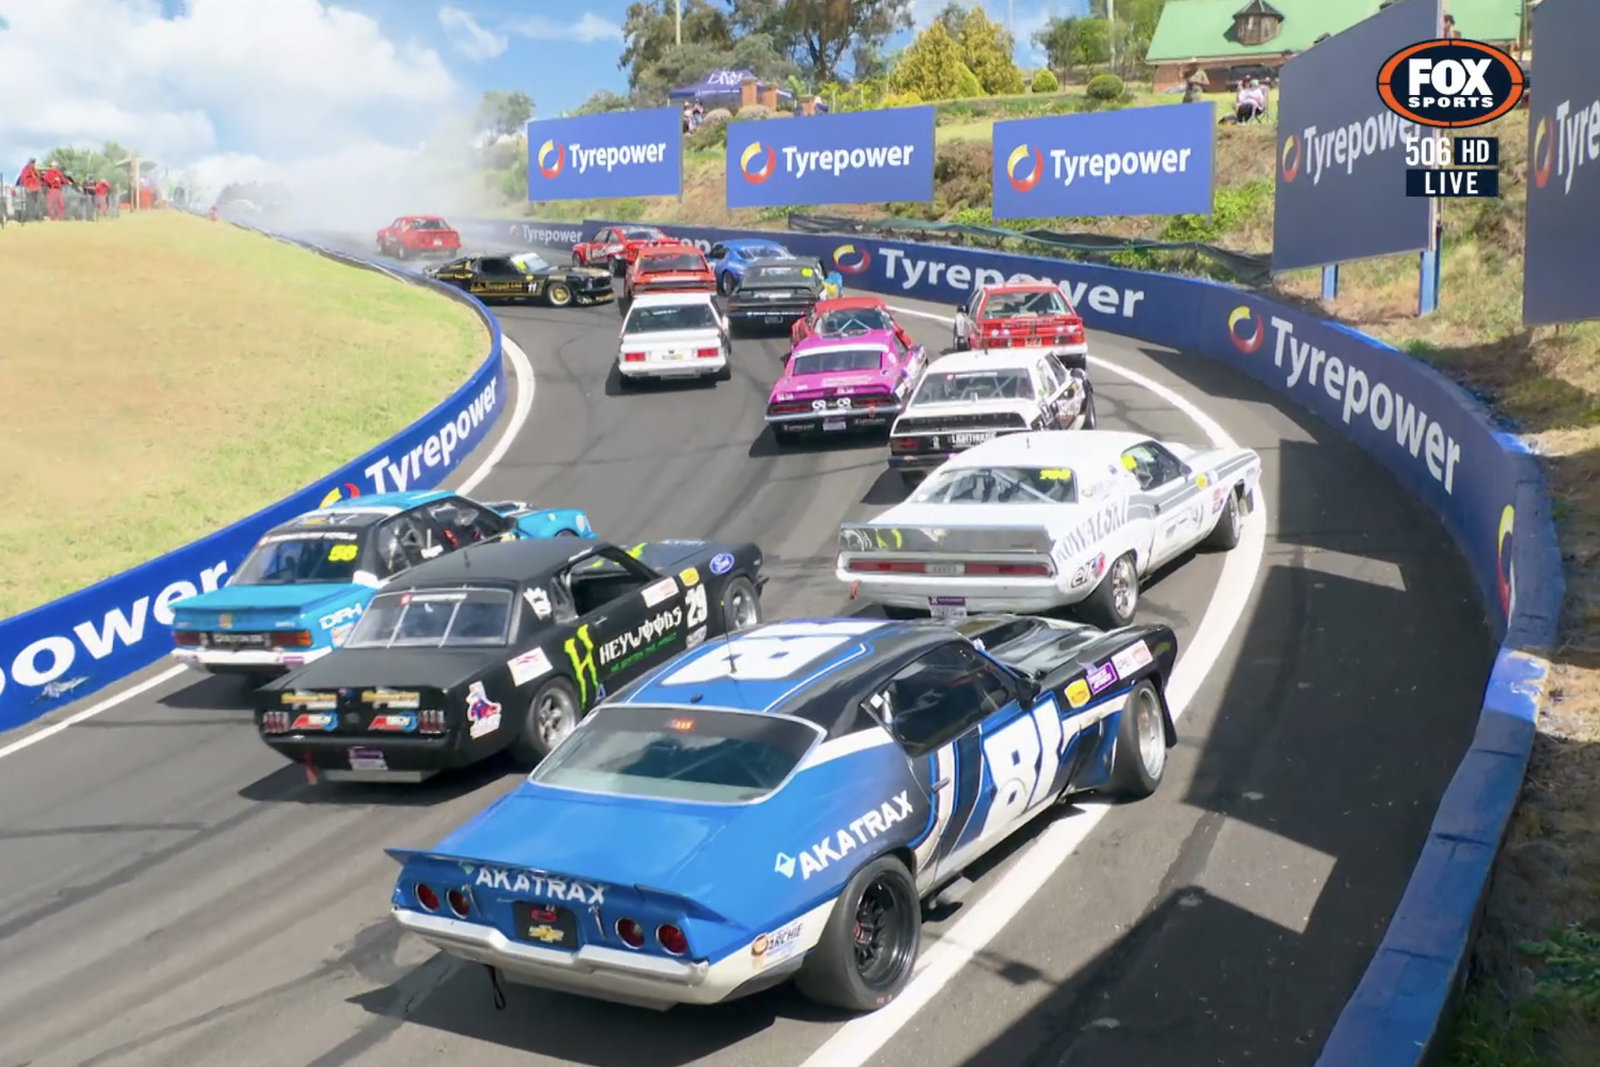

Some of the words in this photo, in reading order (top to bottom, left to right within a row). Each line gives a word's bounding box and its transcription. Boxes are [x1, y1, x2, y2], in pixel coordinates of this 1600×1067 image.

[569, 142, 666, 174] Tyrepower
[782, 144, 914, 178] Tyrepower
[1050, 148, 1191, 186] Tyrepower
[522, 224, 583, 243] Tyrepower
[1272, 316, 1460, 495] Tyrepower
[365, 376, 497, 494] Tyrepower
[0, 560, 229, 697] ower
[799, 790, 914, 880] AKATRAX
[475, 867, 605, 905] AKATRAX
